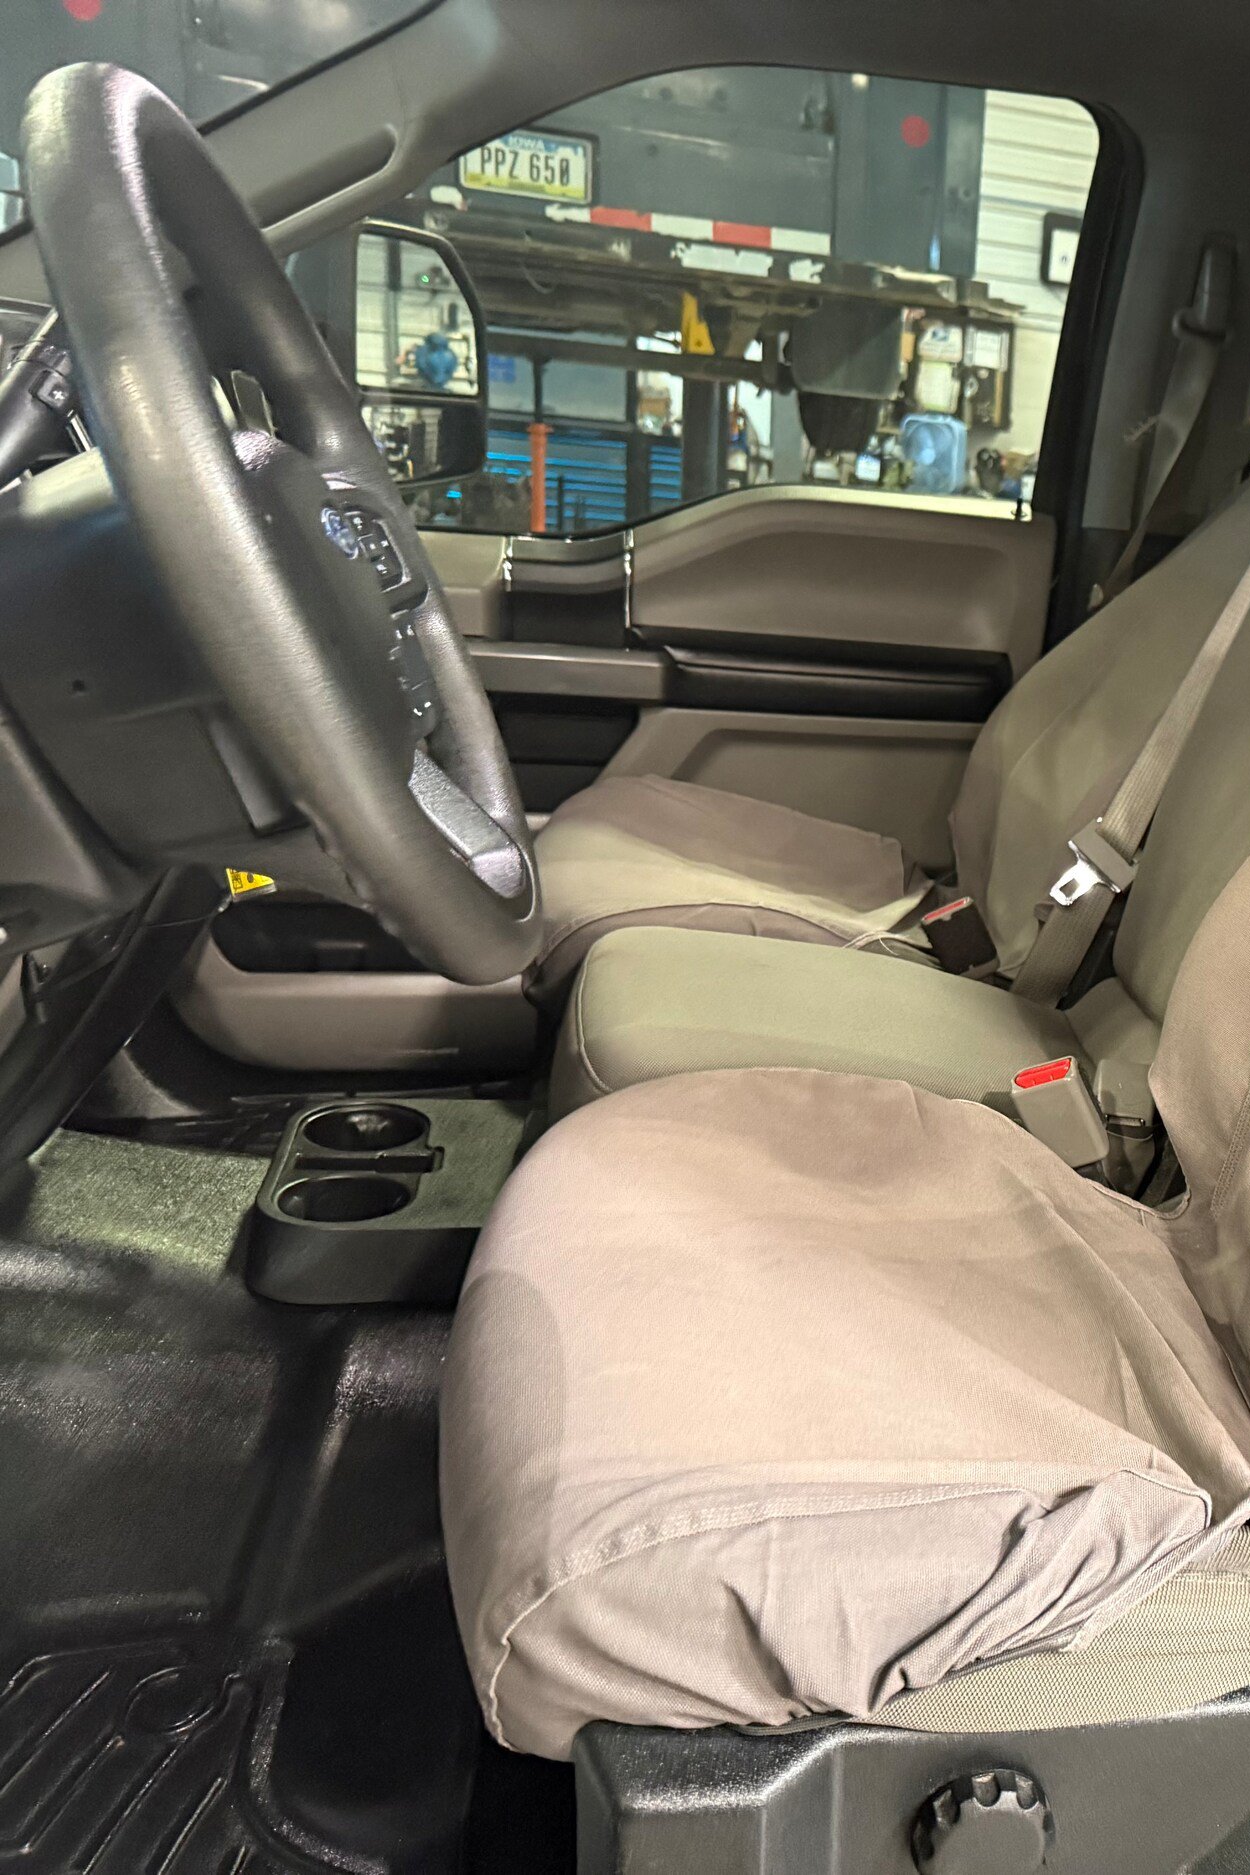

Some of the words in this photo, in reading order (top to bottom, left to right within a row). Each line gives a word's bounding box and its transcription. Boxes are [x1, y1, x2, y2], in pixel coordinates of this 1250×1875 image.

[507, 135, 546, 151] IOWA
[480, 146, 520, 180] PPZ
[529, 152, 570, 187] 650
